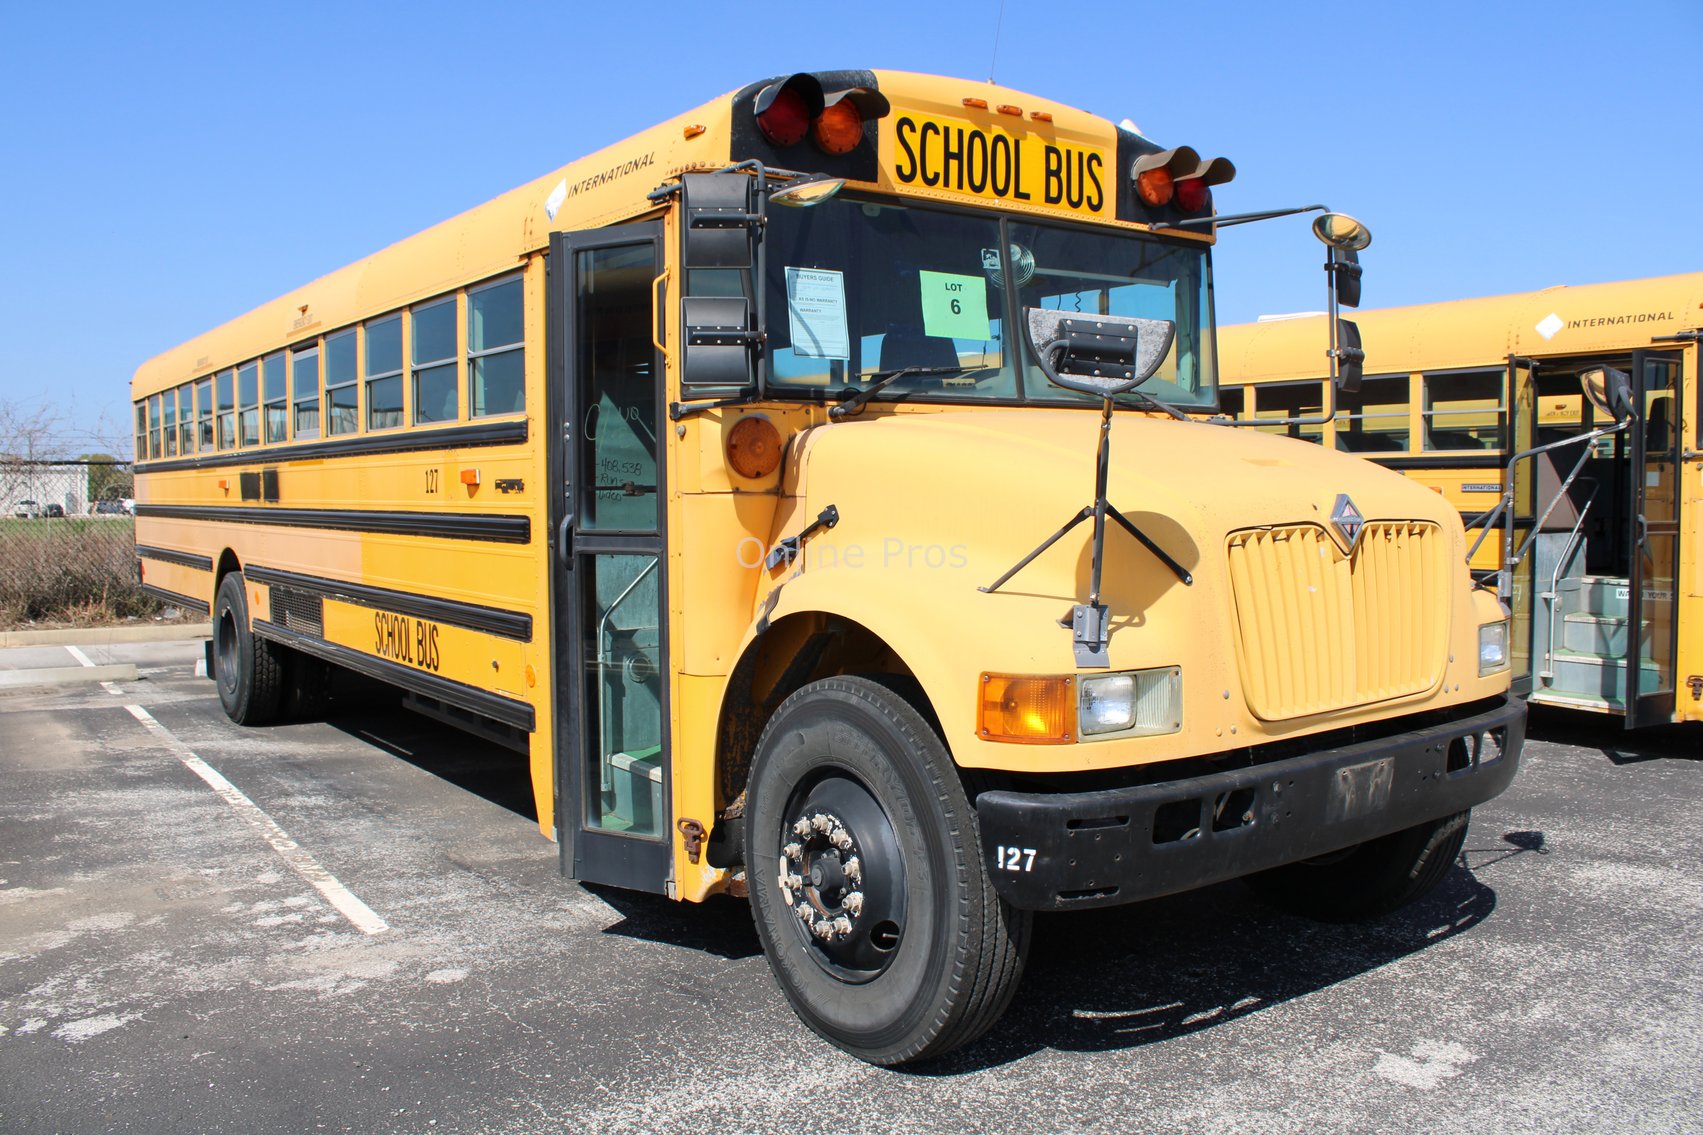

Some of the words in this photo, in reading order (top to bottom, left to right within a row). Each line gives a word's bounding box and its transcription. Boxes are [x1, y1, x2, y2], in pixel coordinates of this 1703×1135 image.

[567, 151, 656, 199] INTERNATIONAL
[895, 116, 1031, 201] SCHOOL
[1044, 145, 1104, 213] BUS
[818, 275, 834, 283] GUIDE
[945, 282, 963, 292] LOT
[950, 298, 962, 315] 6
[1567, 311, 1675, 329] INTERNATIONAL
[425, 469, 438, 494] 127
[375, 611, 413, 664] SCHOOL
[416, 620, 440, 672] BUS
[997, 845, 1037, 872] 127
[754, 867, 809, 993] YOKOHAMA
